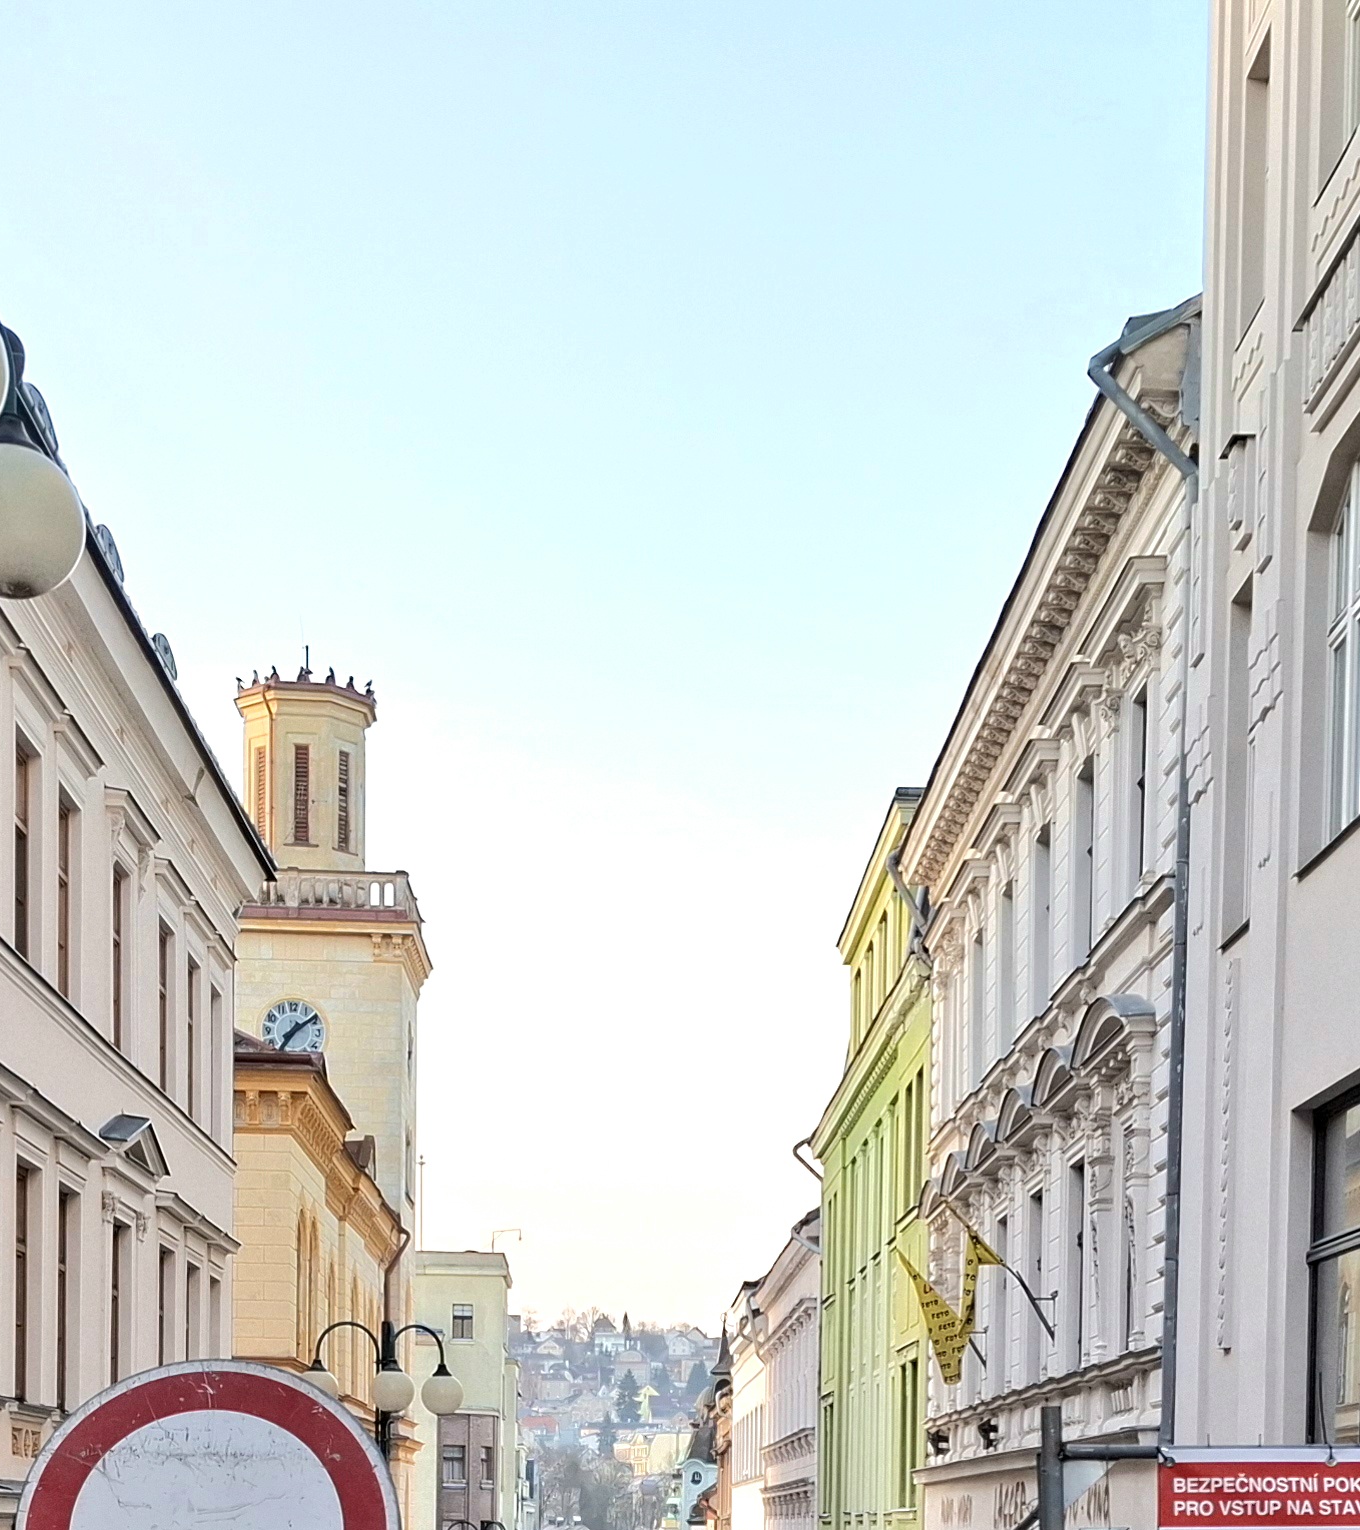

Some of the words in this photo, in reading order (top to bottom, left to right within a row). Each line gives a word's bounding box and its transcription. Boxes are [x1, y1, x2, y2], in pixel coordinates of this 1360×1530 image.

[289, 1002, 298, 1012] 12
[1173, 1472, 1319, 1494] BEZPEČNOSTNÍ
[1174, 1500, 1214, 1516] PRO
[1220, 1499, 1282, 1516] VSTUP
[1287, 1499, 1314, 1516] NA
